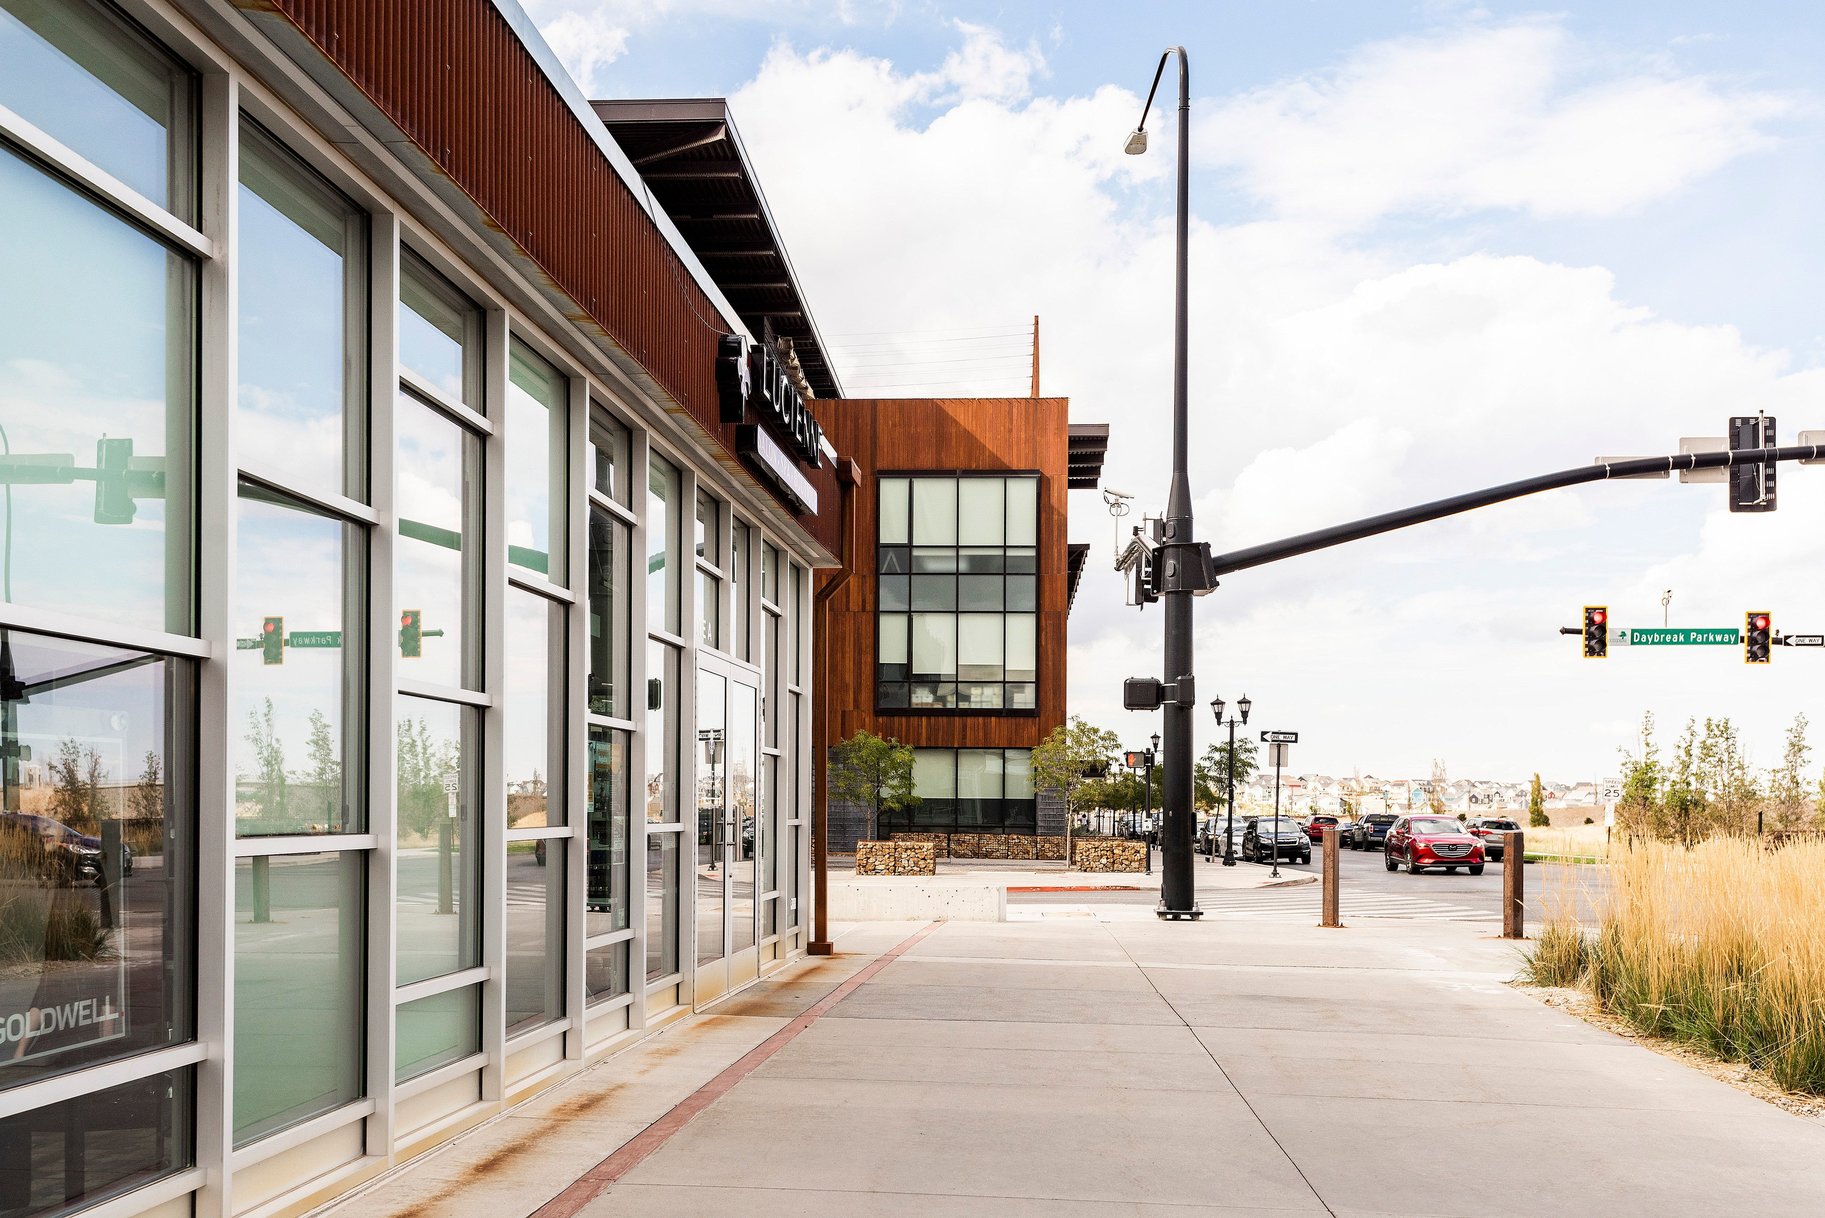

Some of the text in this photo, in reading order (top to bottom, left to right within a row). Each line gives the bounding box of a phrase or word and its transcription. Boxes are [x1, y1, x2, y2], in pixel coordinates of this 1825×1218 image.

[763, 344, 823, 470] LUCIENNE
[1633, 631, 1685, 643] Daybreak
[1690, 632, 1736, 644] Parkway
[1604, 789, 1620, 798] 25
